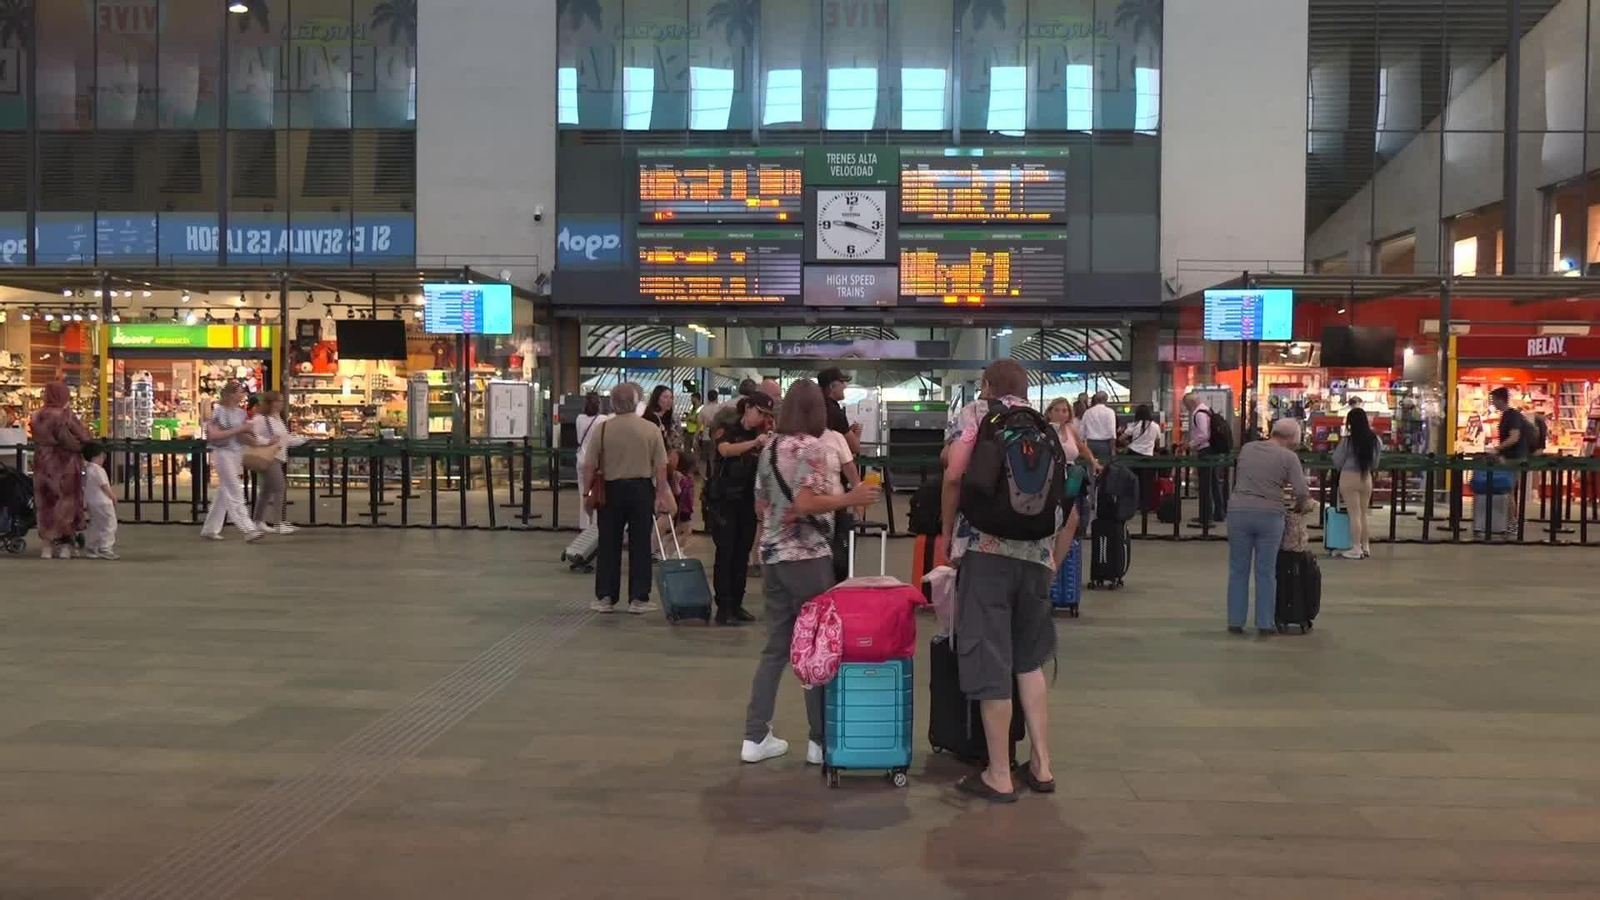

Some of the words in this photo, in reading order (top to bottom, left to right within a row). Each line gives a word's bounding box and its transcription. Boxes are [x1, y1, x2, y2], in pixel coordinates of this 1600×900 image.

[826, 153, 856, 165] TRENES
[859, 153, 878, 165] ALTA
[830, 165, 873, 177] VELOCIDAD
[845, 195, 859, 206] 12
[822, 220, 831, 230] 9
[871, 220, 880, 230] 3
[846, 245, 856, 254] 6
[826, 274, 848, 285] HIGH
[850, 274, 875, 285] SPEED
[837, 286, 865, 298] TRAINS
[793, 342, 801, 354] 6
[1527, 336, 1565, 356] RELAY
